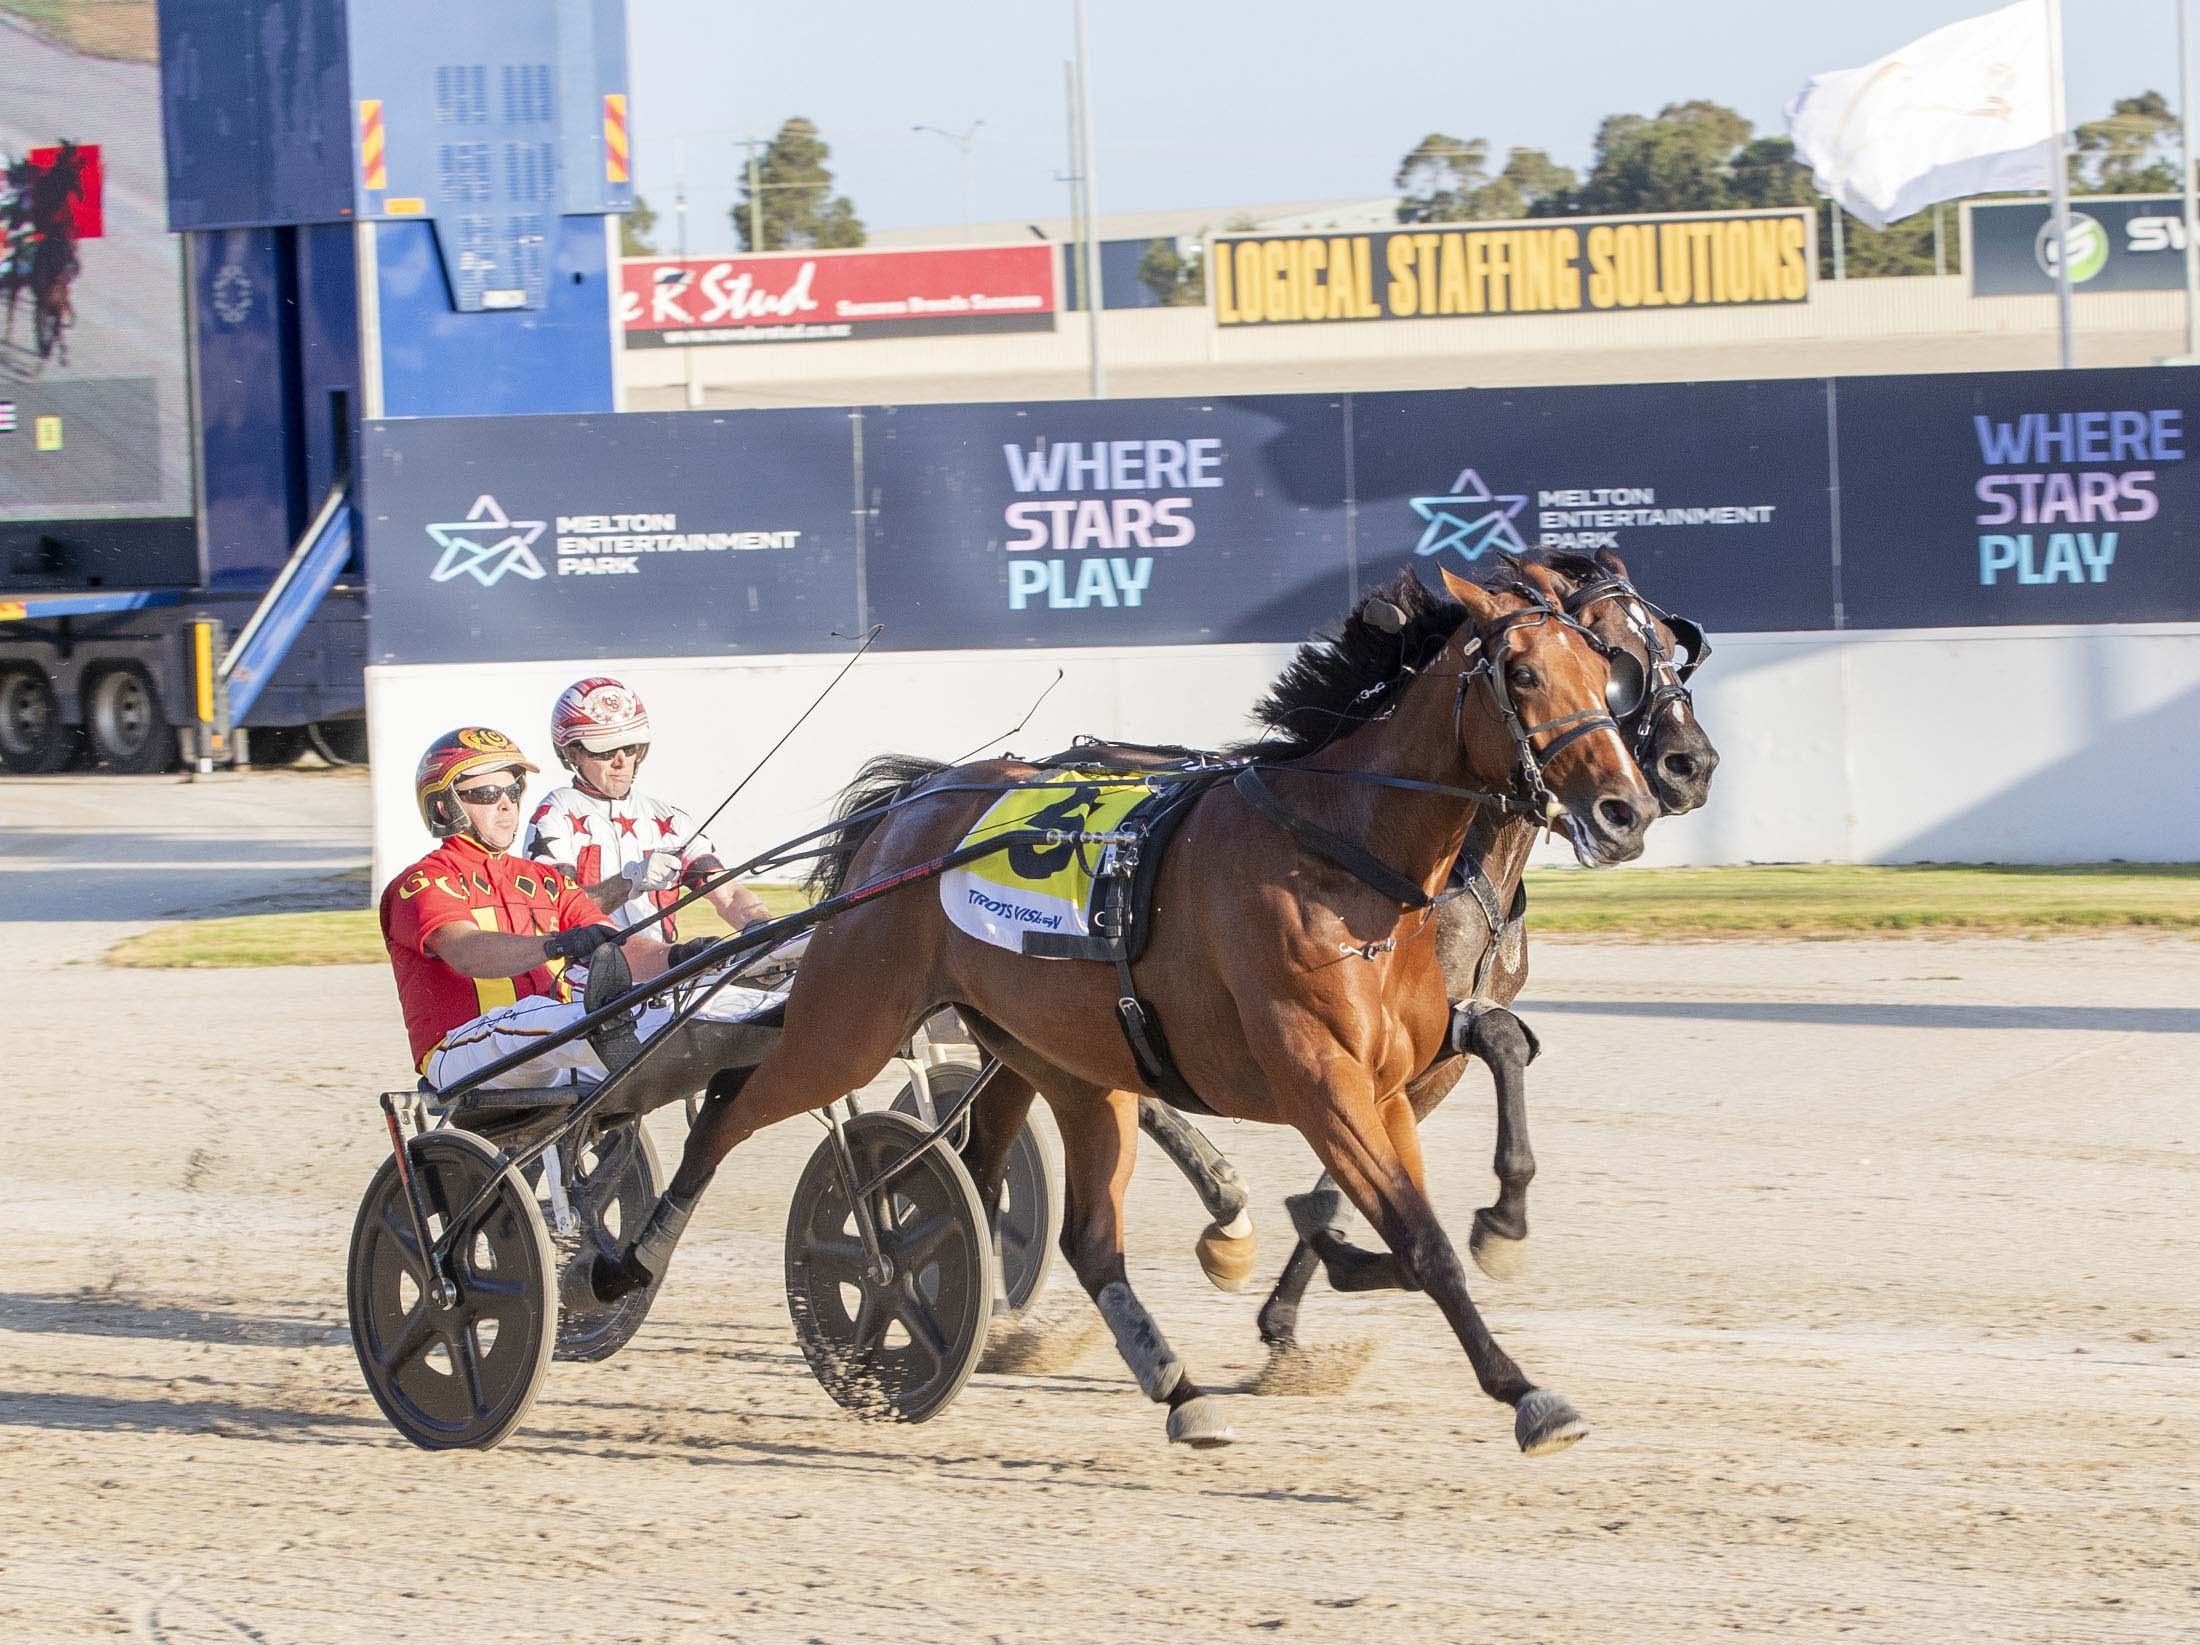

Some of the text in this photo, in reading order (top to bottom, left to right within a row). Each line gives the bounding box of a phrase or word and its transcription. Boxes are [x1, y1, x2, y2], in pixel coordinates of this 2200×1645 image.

[700, 262, 819, 323] Stud
[1214, 218, 1807, 325] LOGICAL STAFFING SOLUTIONS
[1973, 409, 2186, 465] WHERE
[1003, 438, 1224, 492] WHERE
[556, 514, 676, 534] MELTON
[1004, 497, 1196, 551] STARS
[1538, 488, 1655, 508] MELTON
[1538, 506, 1776, 529] ENTERTAINMENT
[1975, 470, 2159, 525] STARS
[557, 531, 801, 555] ENTERTAINMENT
[557, 556, 640, 576] PARK
[1539, 531, 1619, 549] PARK
[1978, 532, 2119, 586] PLAY
[1008, 557, 1154, 610] PLAY
